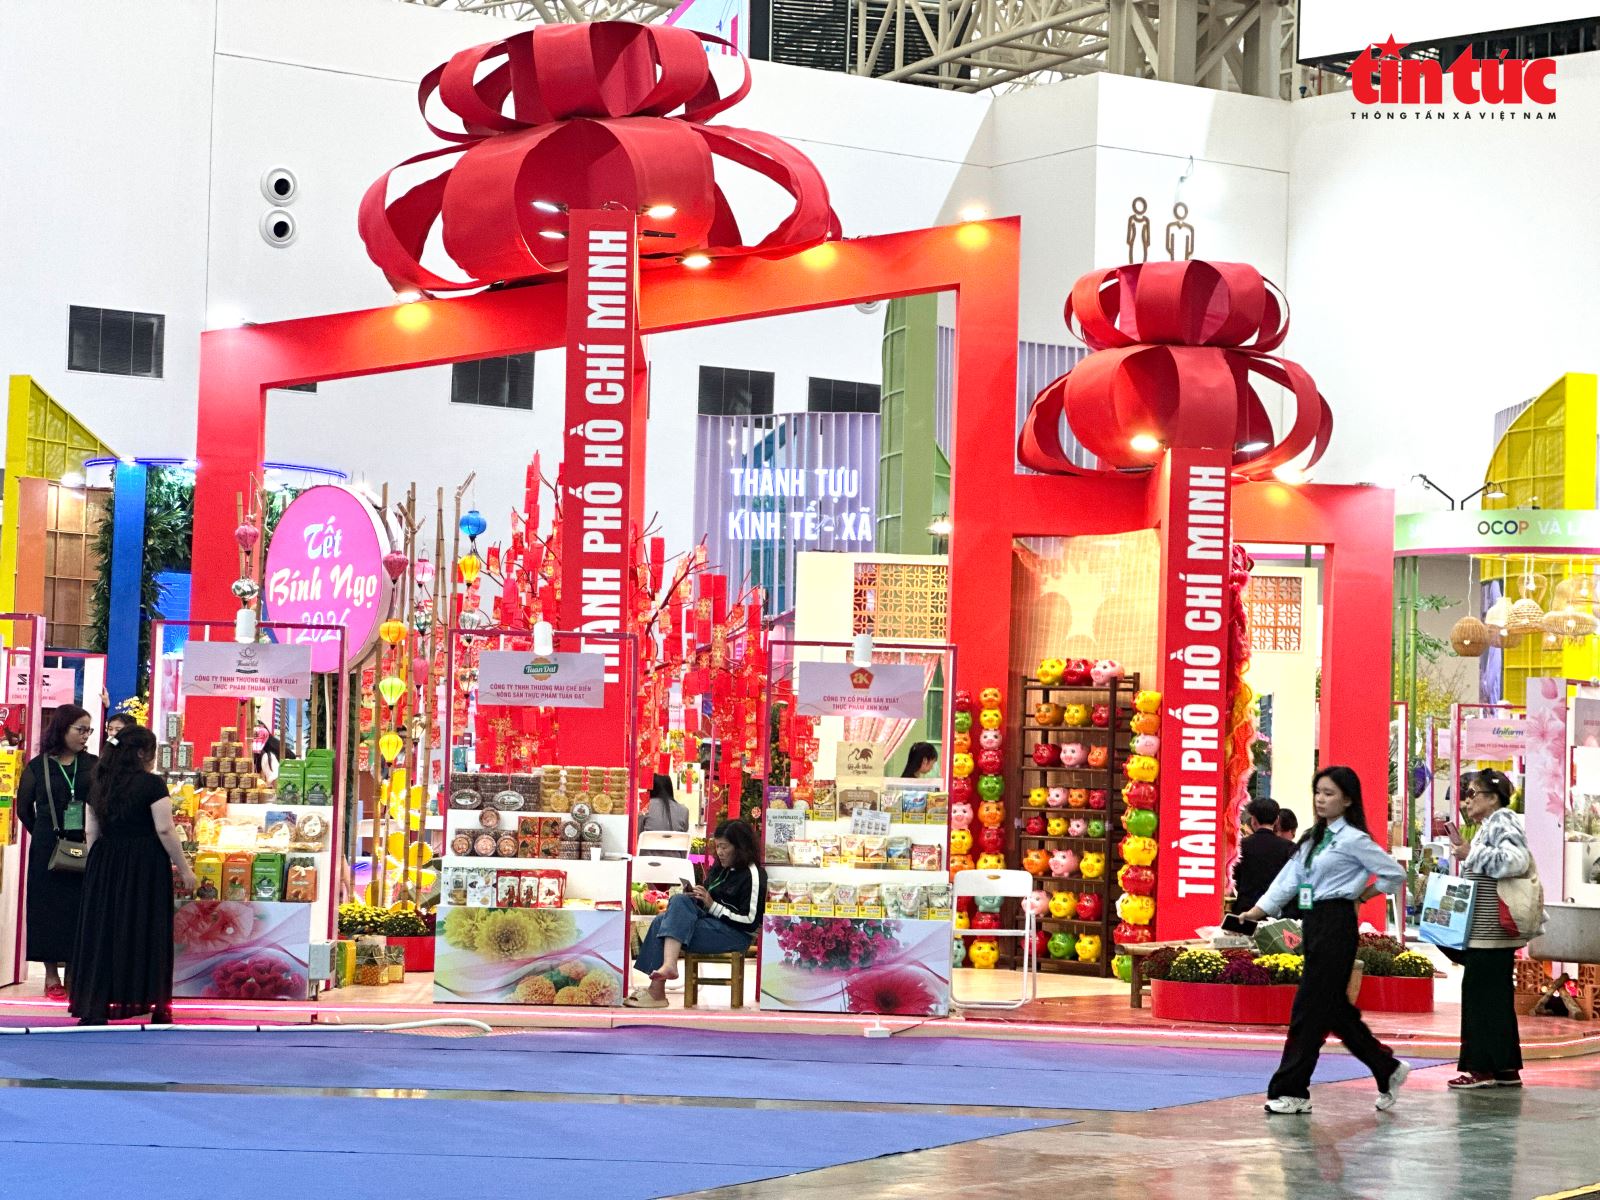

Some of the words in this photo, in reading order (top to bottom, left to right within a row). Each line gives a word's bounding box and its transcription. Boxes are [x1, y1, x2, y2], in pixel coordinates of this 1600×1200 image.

[587, 230, 627, 330] MINH
[578, 343, 626, 405] CHÍ
[570, 418, 624, 467] HỒ
[730, 462, 805, 497] THÀNH
[814, 466, 858, 504] TỰU
[304, 515, 343, 560] Tết
[568, 482, 622, 553] PHỐ
[728, 512, 780, 540] KINH
[841, 507, 872, 542] XÃ
[1187, 466, 1226, 560] MINH
[1478, 520, 1530, 535] OCOP
[269, 566, 322, 606] Bính
[330, 564, 378, 608] Ngọ
[1178, 572, 1222, 632] CHÍ
[1170, 644, 1221, 690] HỒ
[1168, 704, 1220, 772] PHỐ
[1172, 785, 1218, 898] THÀNH
